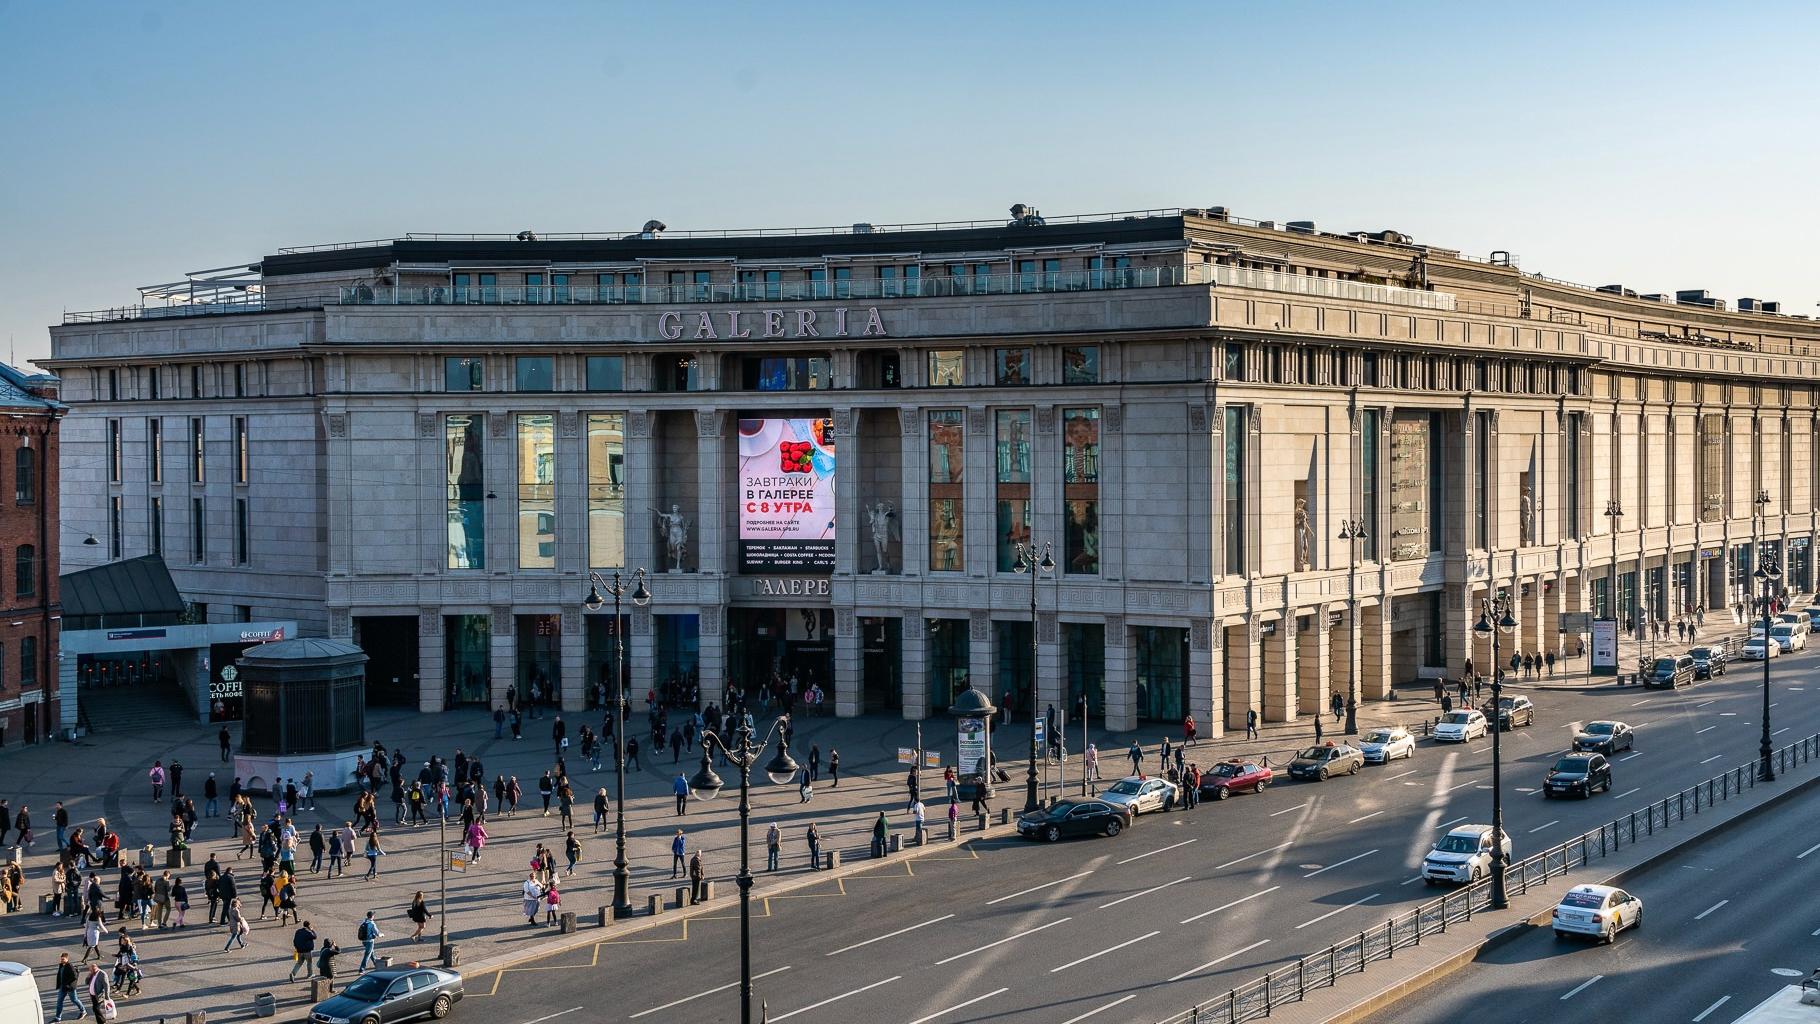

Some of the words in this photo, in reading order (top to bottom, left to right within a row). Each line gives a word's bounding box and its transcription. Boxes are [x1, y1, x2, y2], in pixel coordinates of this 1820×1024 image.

[658, 307, 887, 340] GALERIA
[746, 477, 812, 487] ЗАВТРАКИ
[747, 490, 754, 499] В
[758, 490, 814, 499] ГАЛЕРЕЕ
[746, 502, 756, 513] С
[760, 502, 770, 513] 8
[773, 502, 813, 513] УТРА
[752, 579, 832, 595] ГАЛЕРЕ
